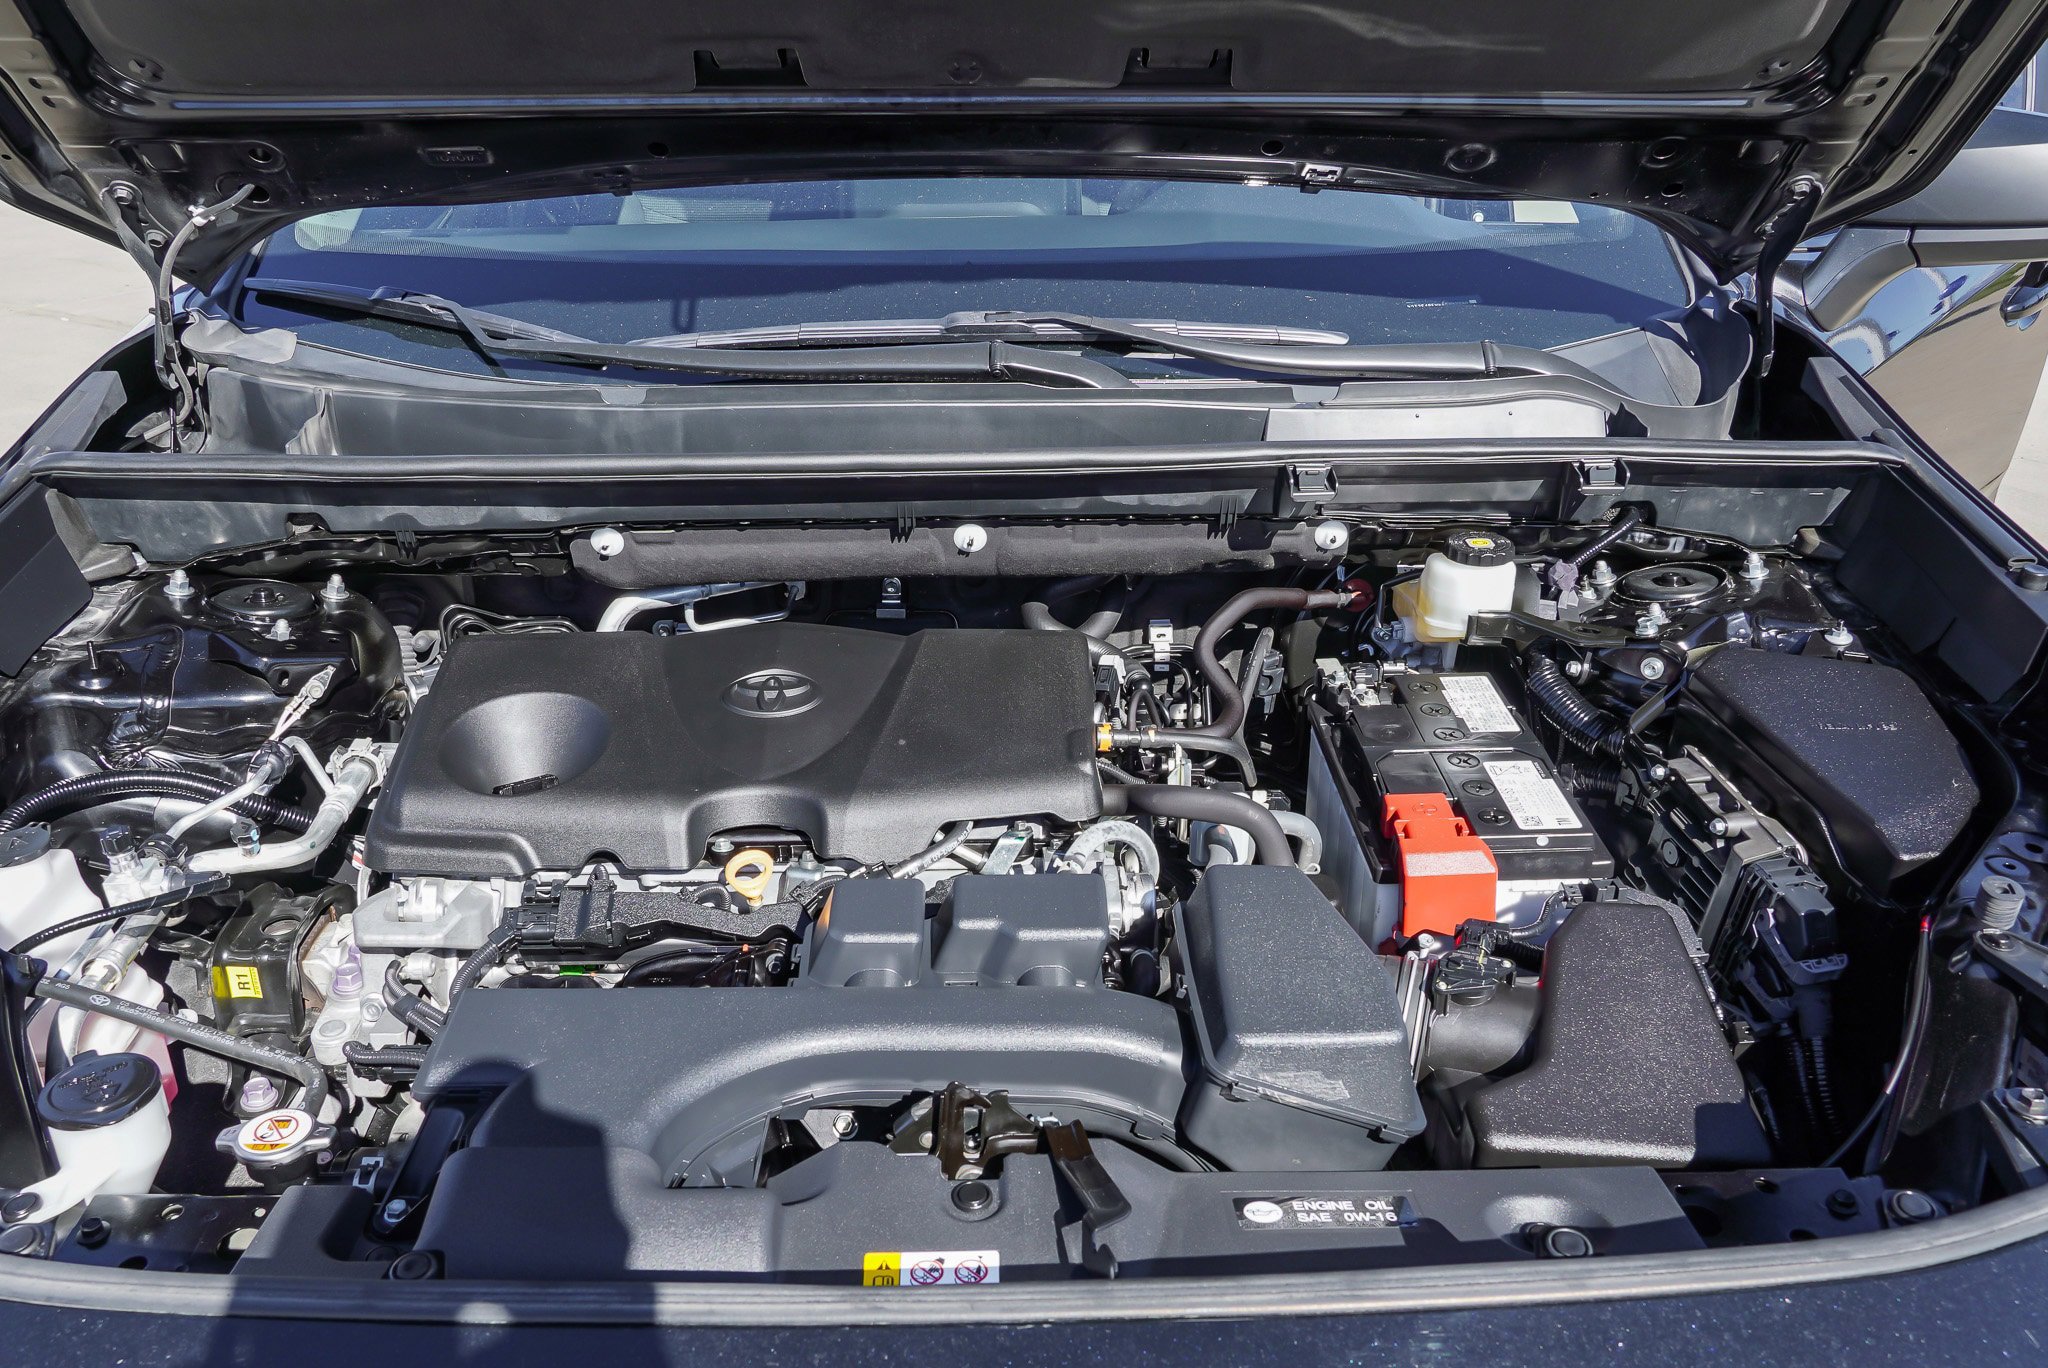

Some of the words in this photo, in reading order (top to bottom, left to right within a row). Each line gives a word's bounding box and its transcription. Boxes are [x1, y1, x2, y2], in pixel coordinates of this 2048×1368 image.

[236, 974, 250, 990] R1
[1292, 1201, 1355, 1210] ENGINE
[1364, 1201, 1394, 1210] OIL
[1297, 1213, 1332, 1222] SAE
[1344, 1212, 1397, 1222] 0W-16
